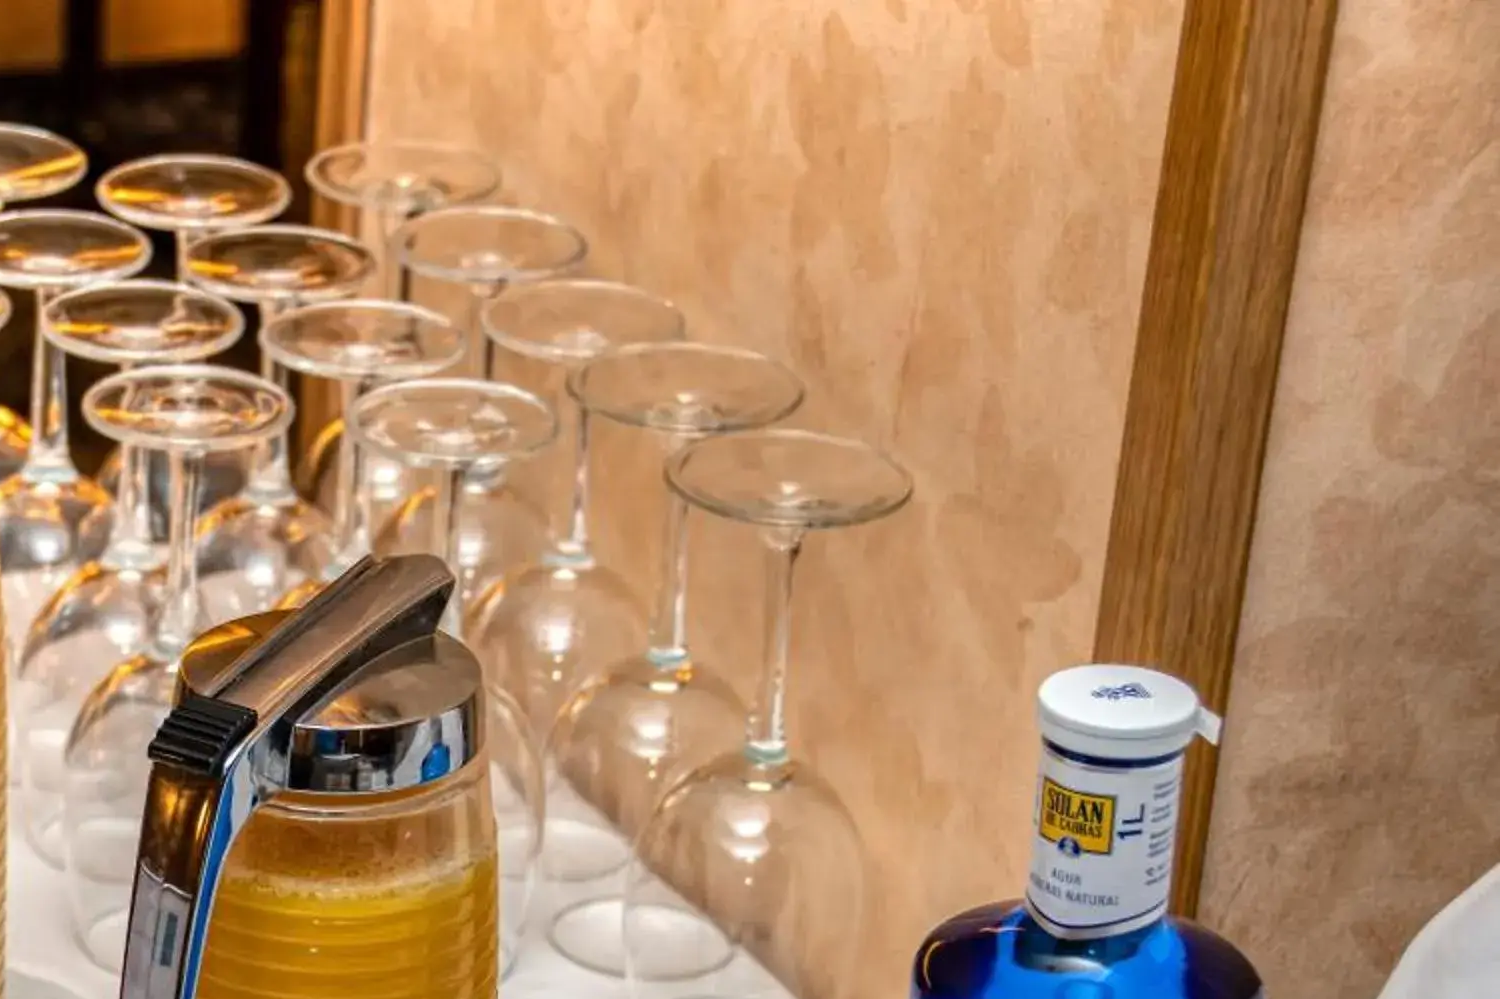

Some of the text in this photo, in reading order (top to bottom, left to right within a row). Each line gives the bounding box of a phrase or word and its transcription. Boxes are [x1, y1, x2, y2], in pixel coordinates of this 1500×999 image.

[1030, 872, 1120, 906] ERAL NATURAL
[1051, 867, 1082, 885] AGUA
